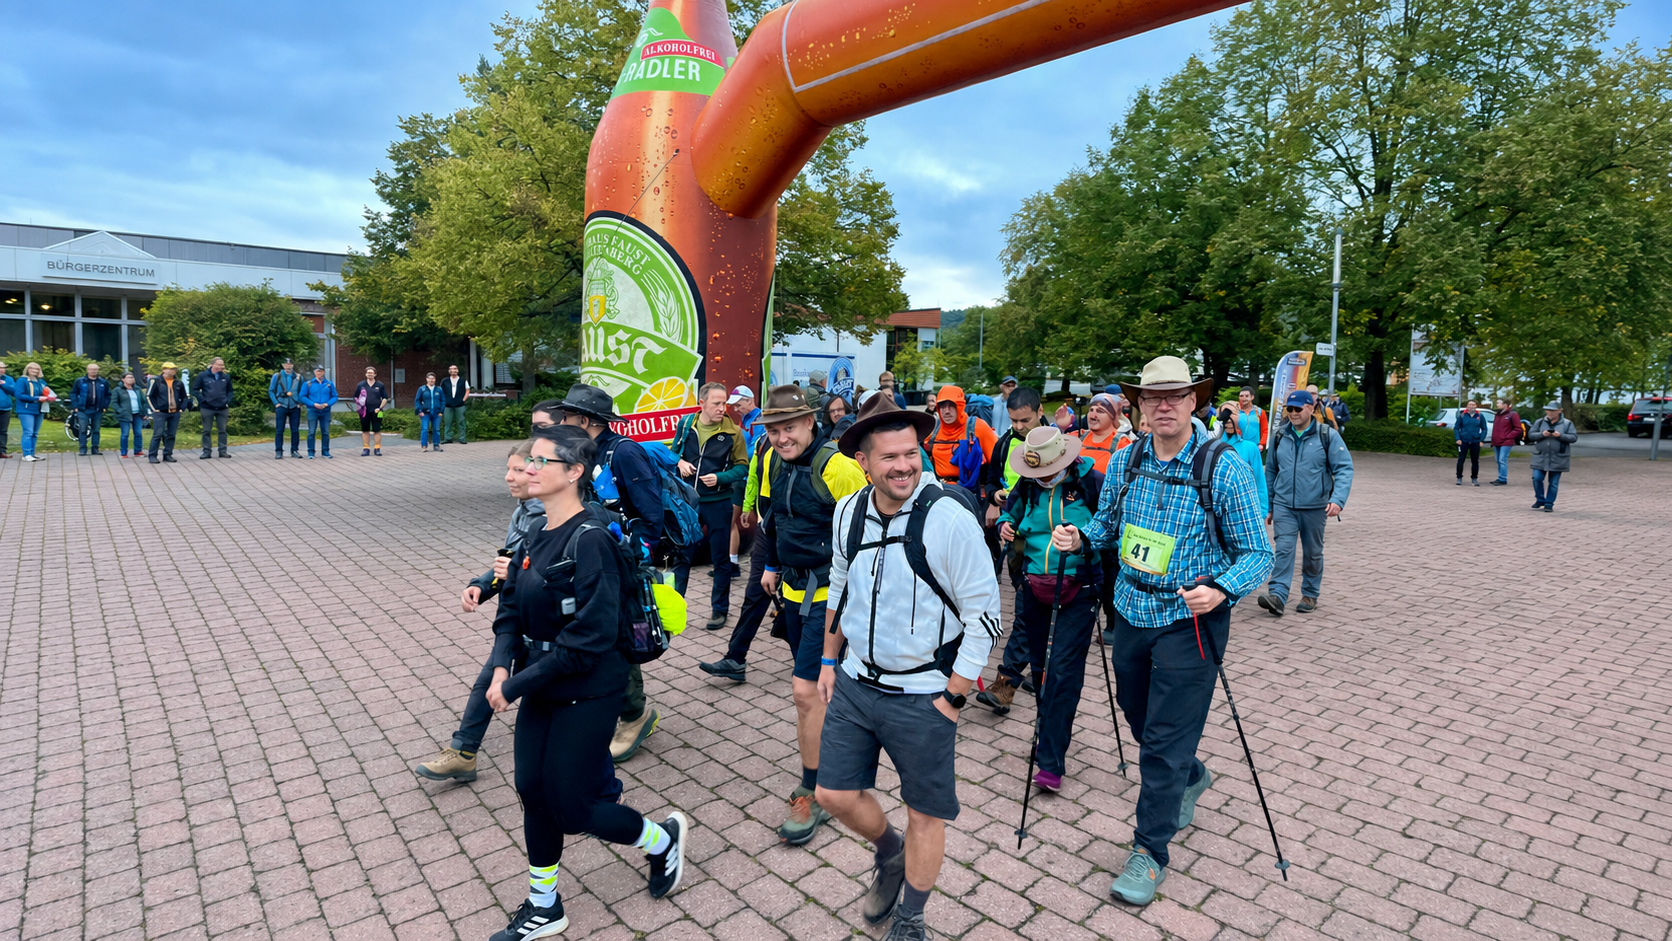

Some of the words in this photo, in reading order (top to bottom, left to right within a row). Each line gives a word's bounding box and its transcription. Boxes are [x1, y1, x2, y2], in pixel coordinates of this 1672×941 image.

[645, 43, 715, 61] ALKOHOLFREI
[611, 235, 651, 265] FAUST
[47, 260, 155, 277] BÜRGERZENTRUM
[1131, 543, 1150, 562] 41
